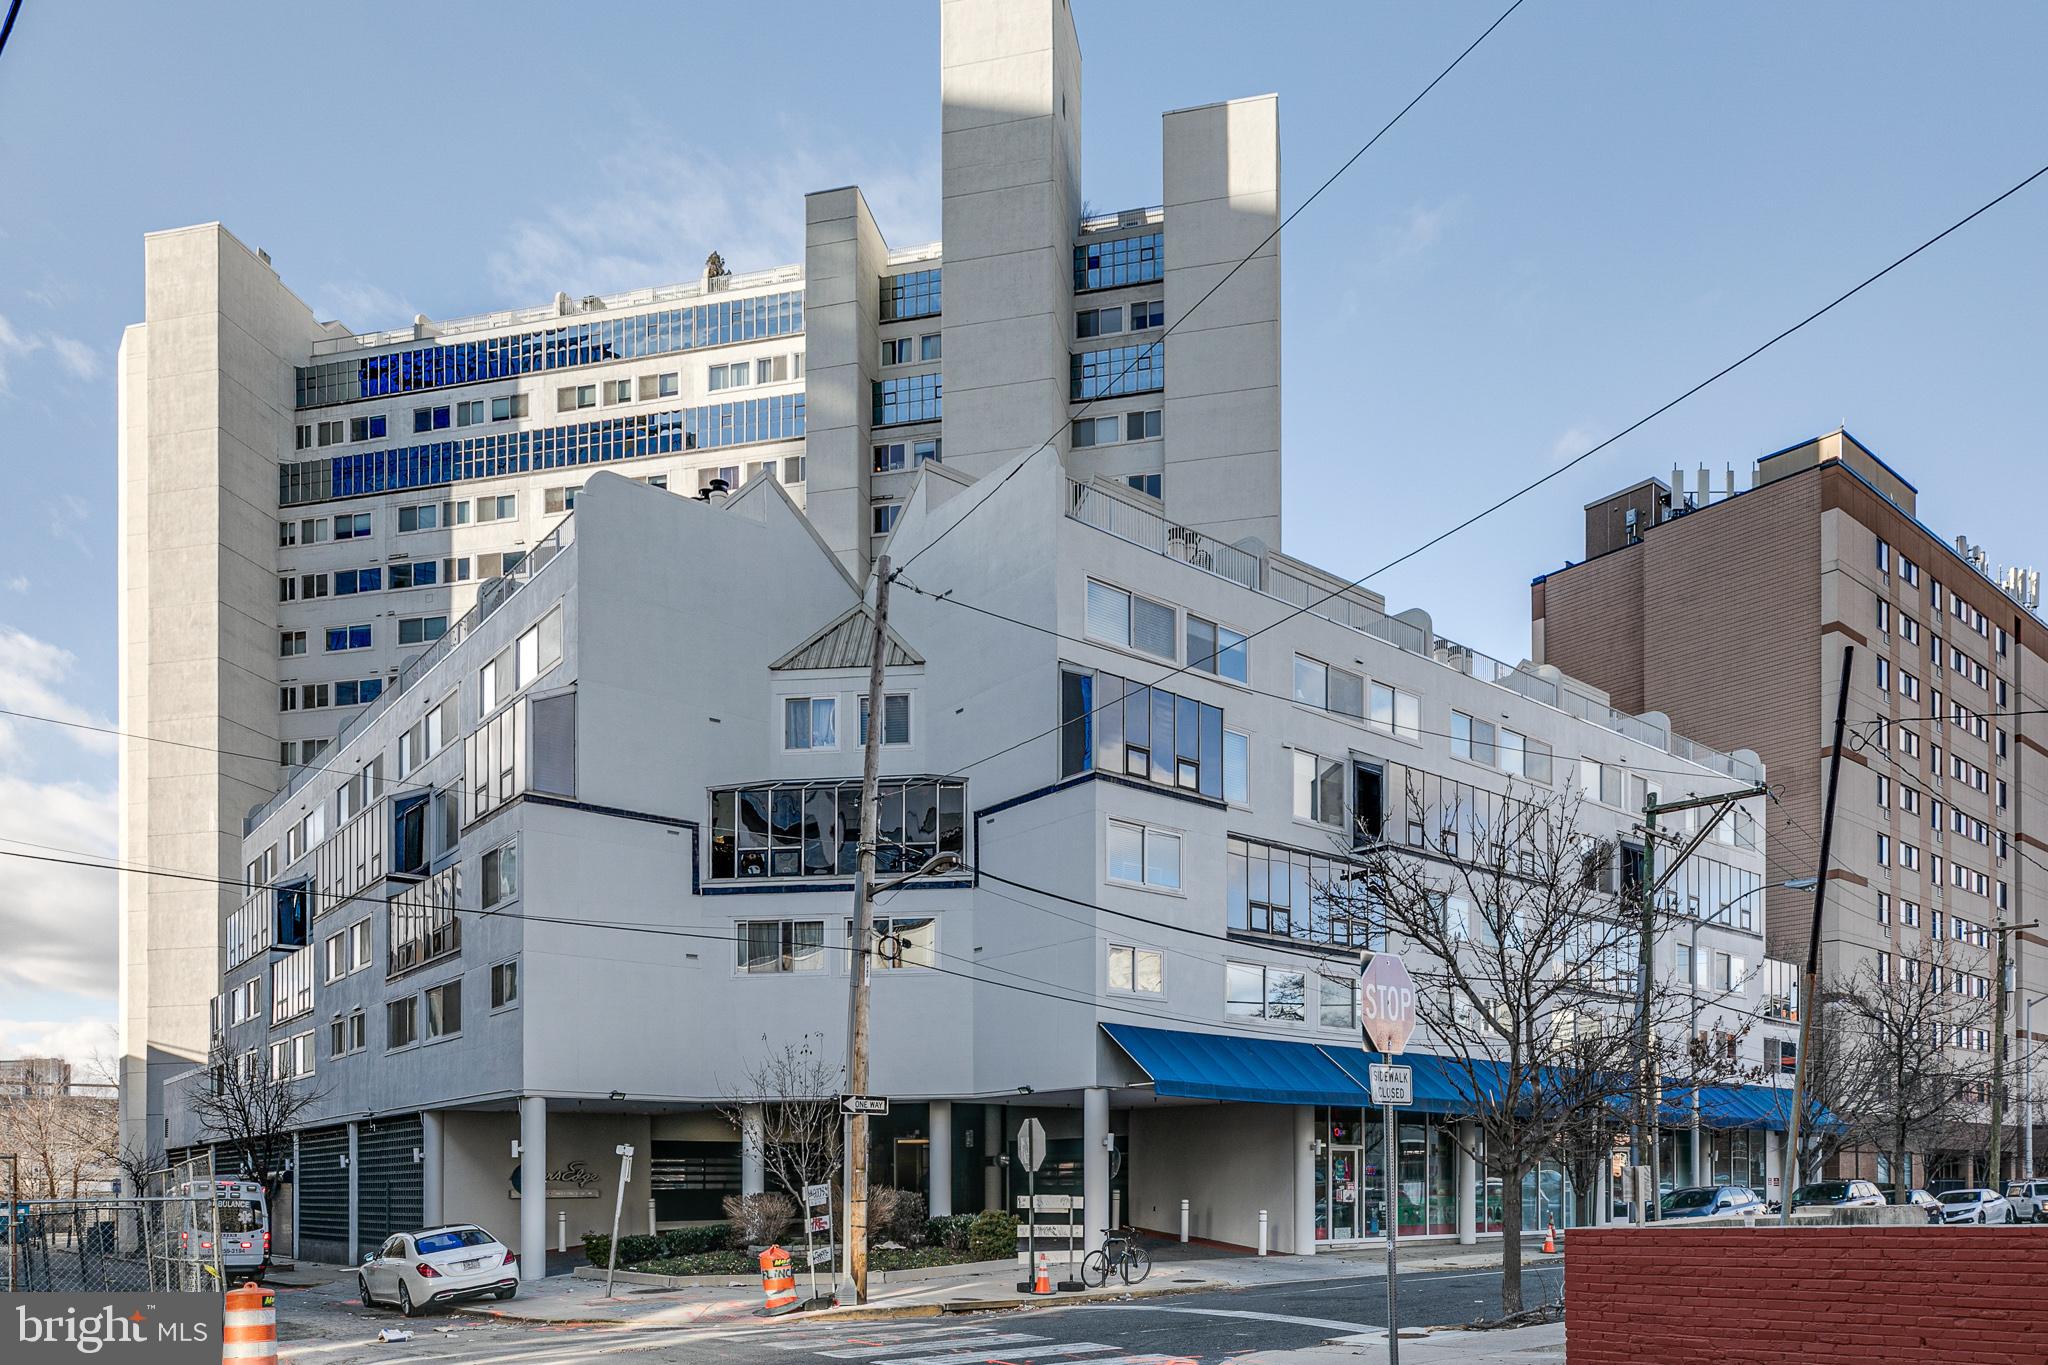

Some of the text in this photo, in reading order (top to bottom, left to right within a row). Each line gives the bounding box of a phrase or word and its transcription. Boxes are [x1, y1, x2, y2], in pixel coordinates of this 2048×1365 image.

[1365, 984, 1411, 1021] STOP
[1373, 1070, 1408, 1083] SIDEWALK
[1378, 1086, 1405, 1099] CLOSED
[207, 1200, 250, 1208] ABULANCE
